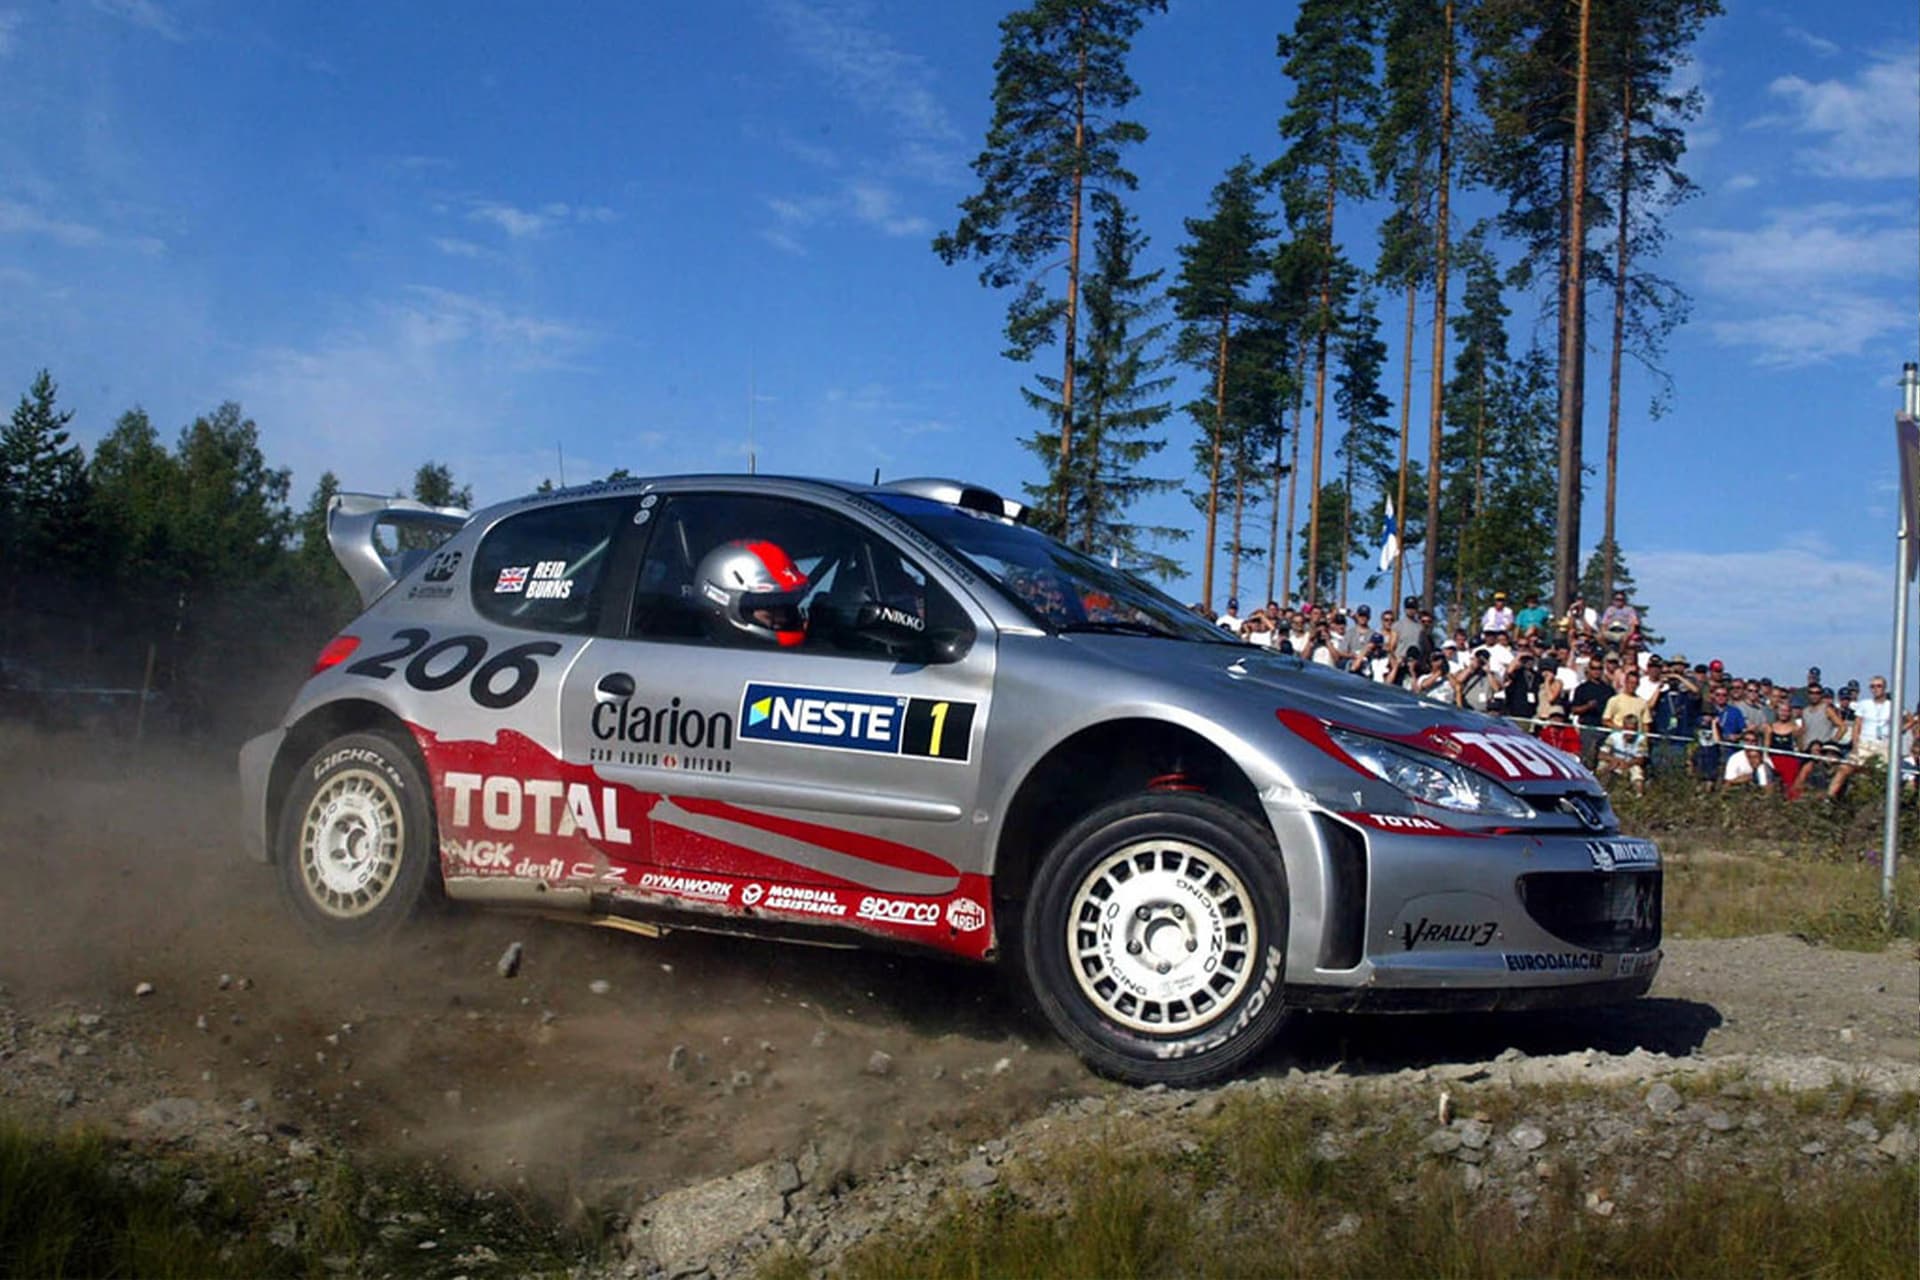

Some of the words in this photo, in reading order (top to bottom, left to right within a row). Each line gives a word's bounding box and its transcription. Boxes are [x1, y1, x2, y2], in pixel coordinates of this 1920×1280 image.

[533, 560, 566, 580] REID
[525, 580, 574, 600] BURNS
[880, 606, 926, 632] NIKKO
[345, 627, 563, 710] 206
[591, 696, 733, 751] Clarion
[771, 696, 893, 741] NESTE
[929, 702, 950, 757] 1
[620, 750, 658, 767] AUDIO
[683, 756, 732, 774] BEYOND
[444, 771, 632, 846] TOTAL
[1369, 813, 1442, 831] TOTAL
[458, 838, 514, 868] NGK
[515, 857, 564, 880] devil
[639, 873, 734, 898] DYNAWORK
[768, 884, 838, 904] MONDIAL
[763, 898, 848, 917] ASSISTANCE
[858, 896, 941, 922] sparco
[1505, 953, 1603, 972] EURODATACAR
